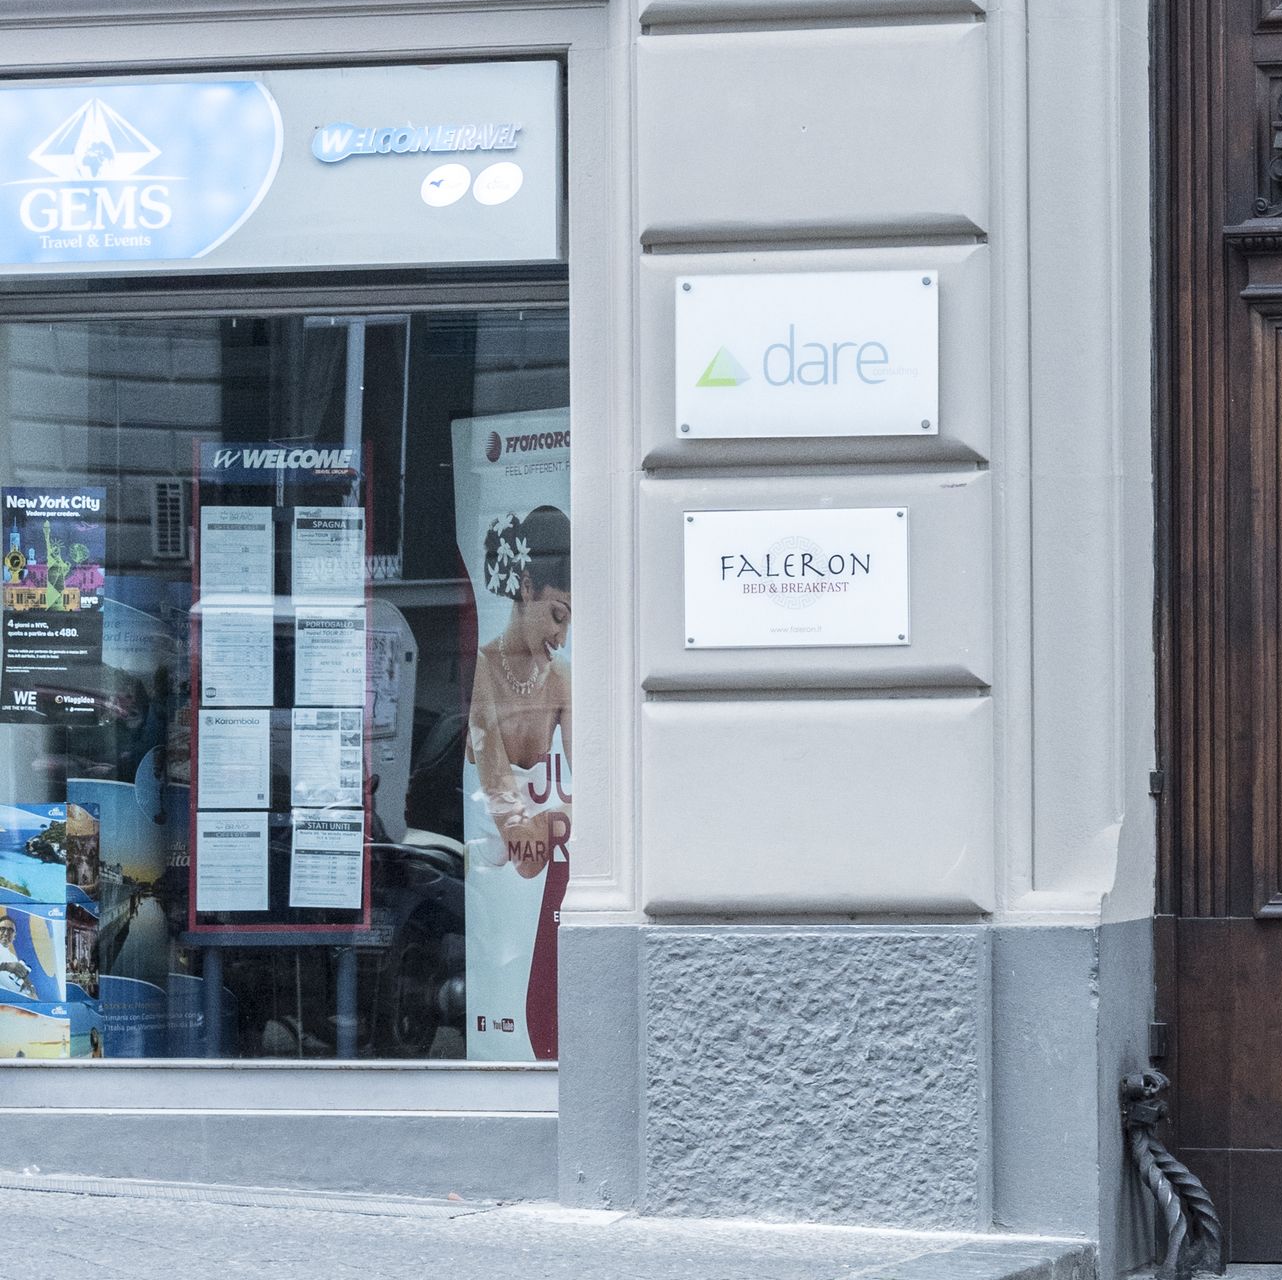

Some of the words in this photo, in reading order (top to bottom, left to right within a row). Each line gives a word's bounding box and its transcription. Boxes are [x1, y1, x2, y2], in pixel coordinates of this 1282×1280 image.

[19, 184, 172, 233] GEMS
[40, 235, 82, 249] Travel
[86, 234, 100, 248] &
[104, 233, 151, 248] Events
[763, 323, 889, 386] dare
[242, 449, 353, 469] WELCOME
[505, 466, 522, 476] FEEL
[6, 495, 37, 508] New
[39, 495, 70, 509] York
[71, 495, 100, 511] City
[721, 553, 870, 580] FALERON
[743, 583, 766, 594] BED
[768, 582, 778, 593] &
[781, 581, 850, 593] BREAKFAST
[14, 690, 37, 705] WE
[64, 695, 95, 705] Viaggidea
